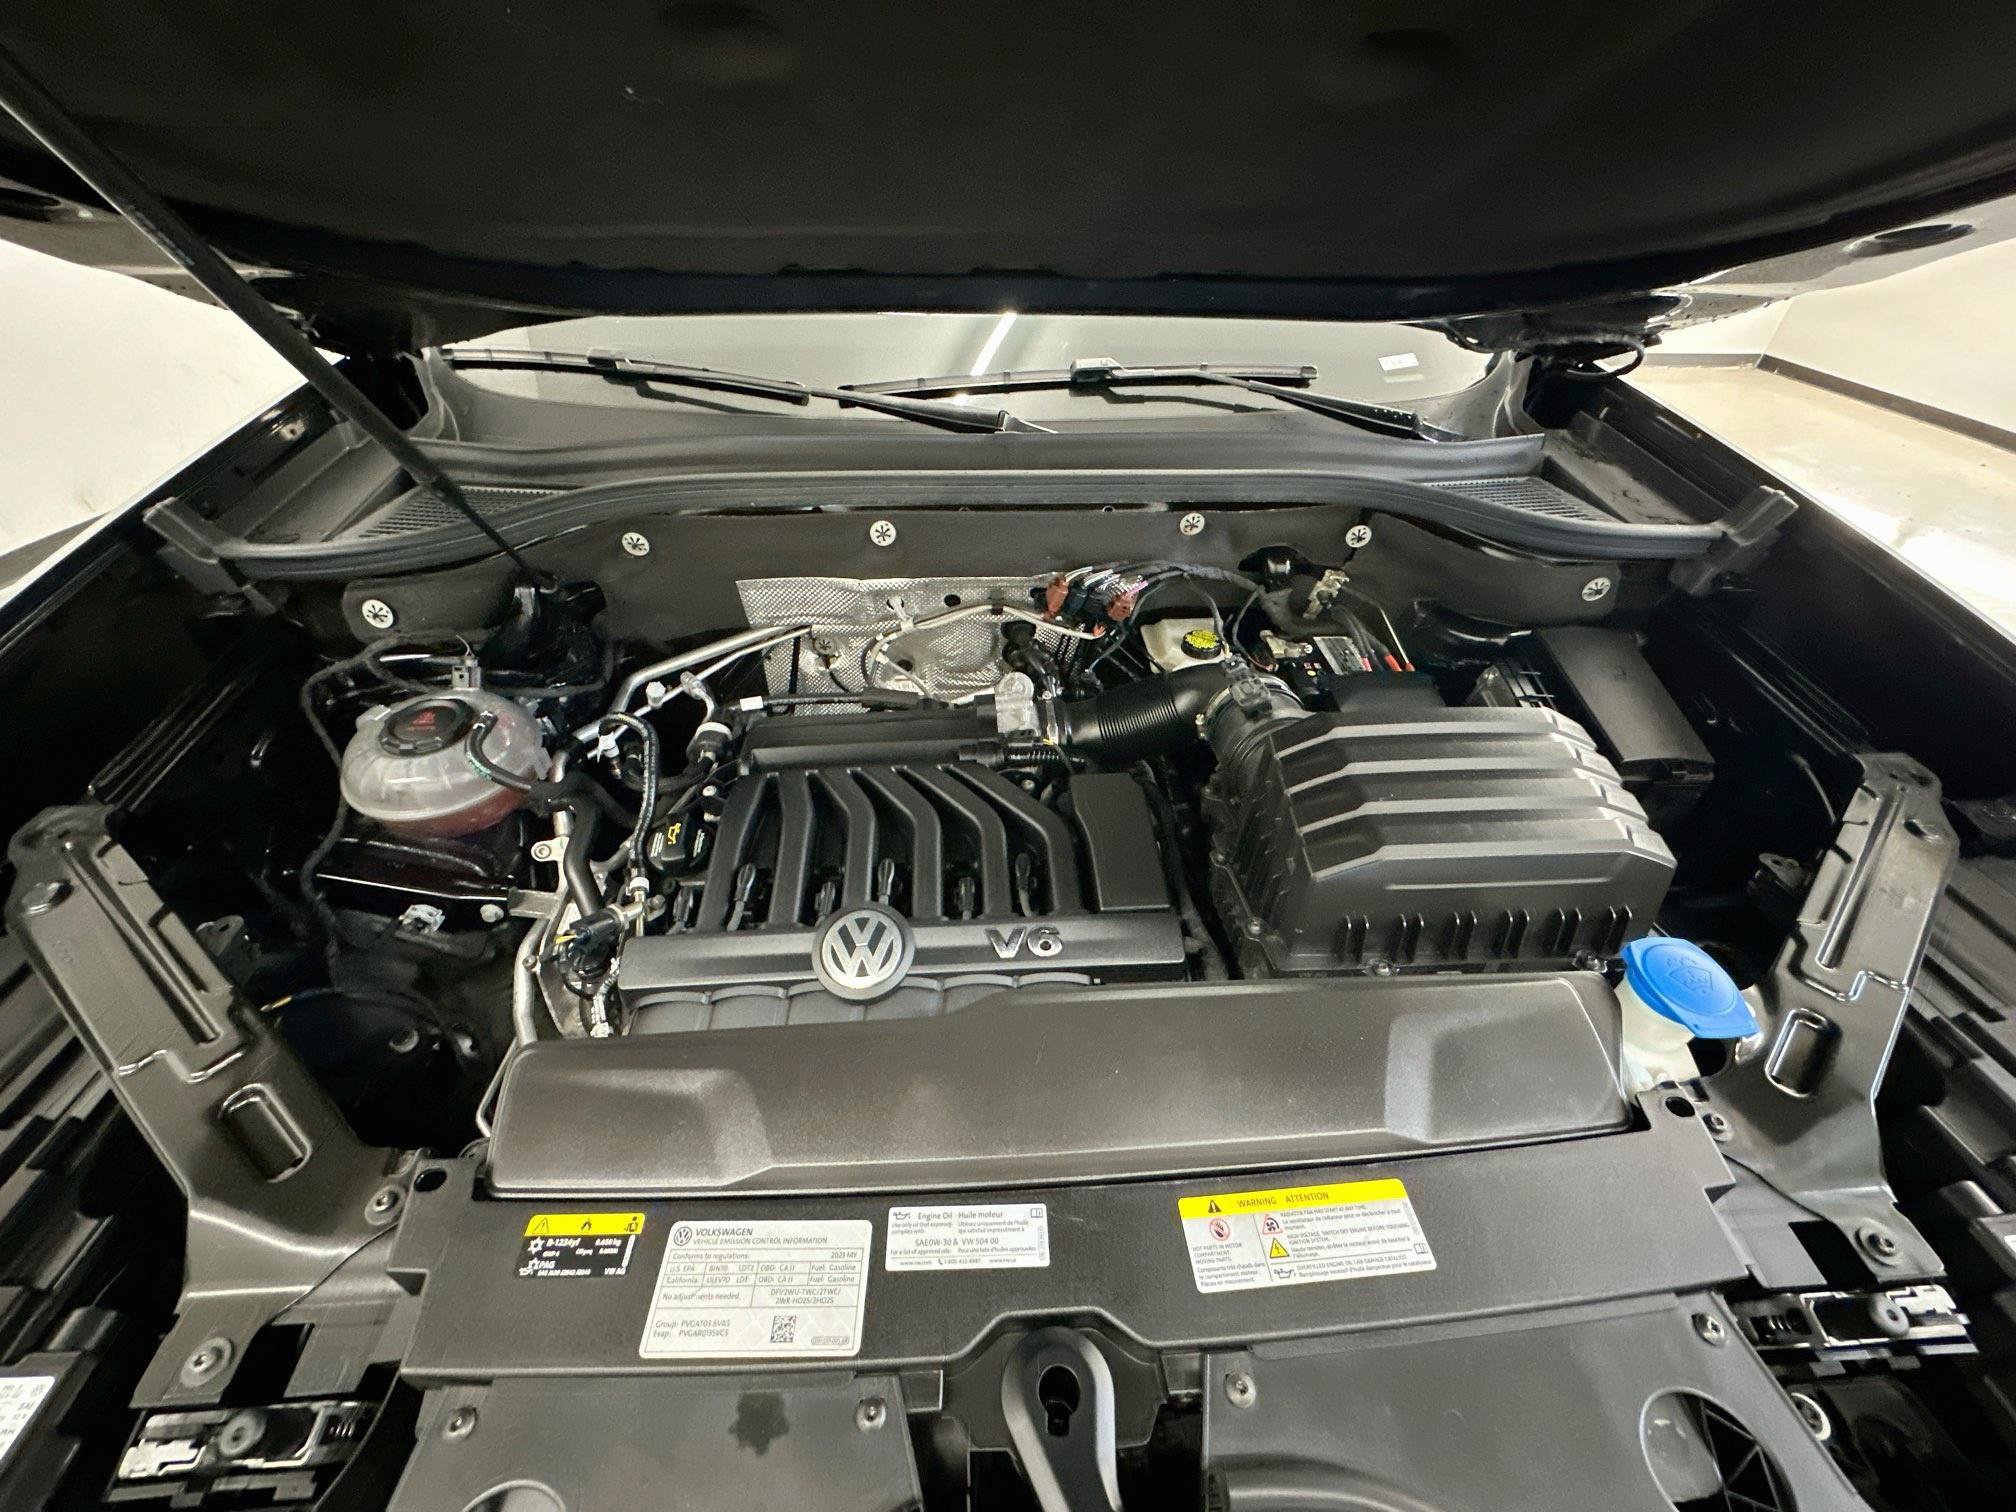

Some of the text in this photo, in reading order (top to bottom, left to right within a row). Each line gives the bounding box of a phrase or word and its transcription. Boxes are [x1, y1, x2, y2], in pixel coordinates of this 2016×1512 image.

[985, 926, 1063, 958] V6
[1236, 1191, 1330, 1207] WARNING ATTENTION
[917, 1210, 1003, 1221] Engine Oil Huile moteur
[694, 1227, 753, 1236] VOLKSWAGEN
[952, 1237, 958, 1245] &
[961, 1237, 973, 1245] VW
[975, 1237, 988, 1245] 504
[989, 1236, 999, 1244] 00
[672, 1252, 703, 1260] Conforms
[538, 1260, 555, 1268] PAG
